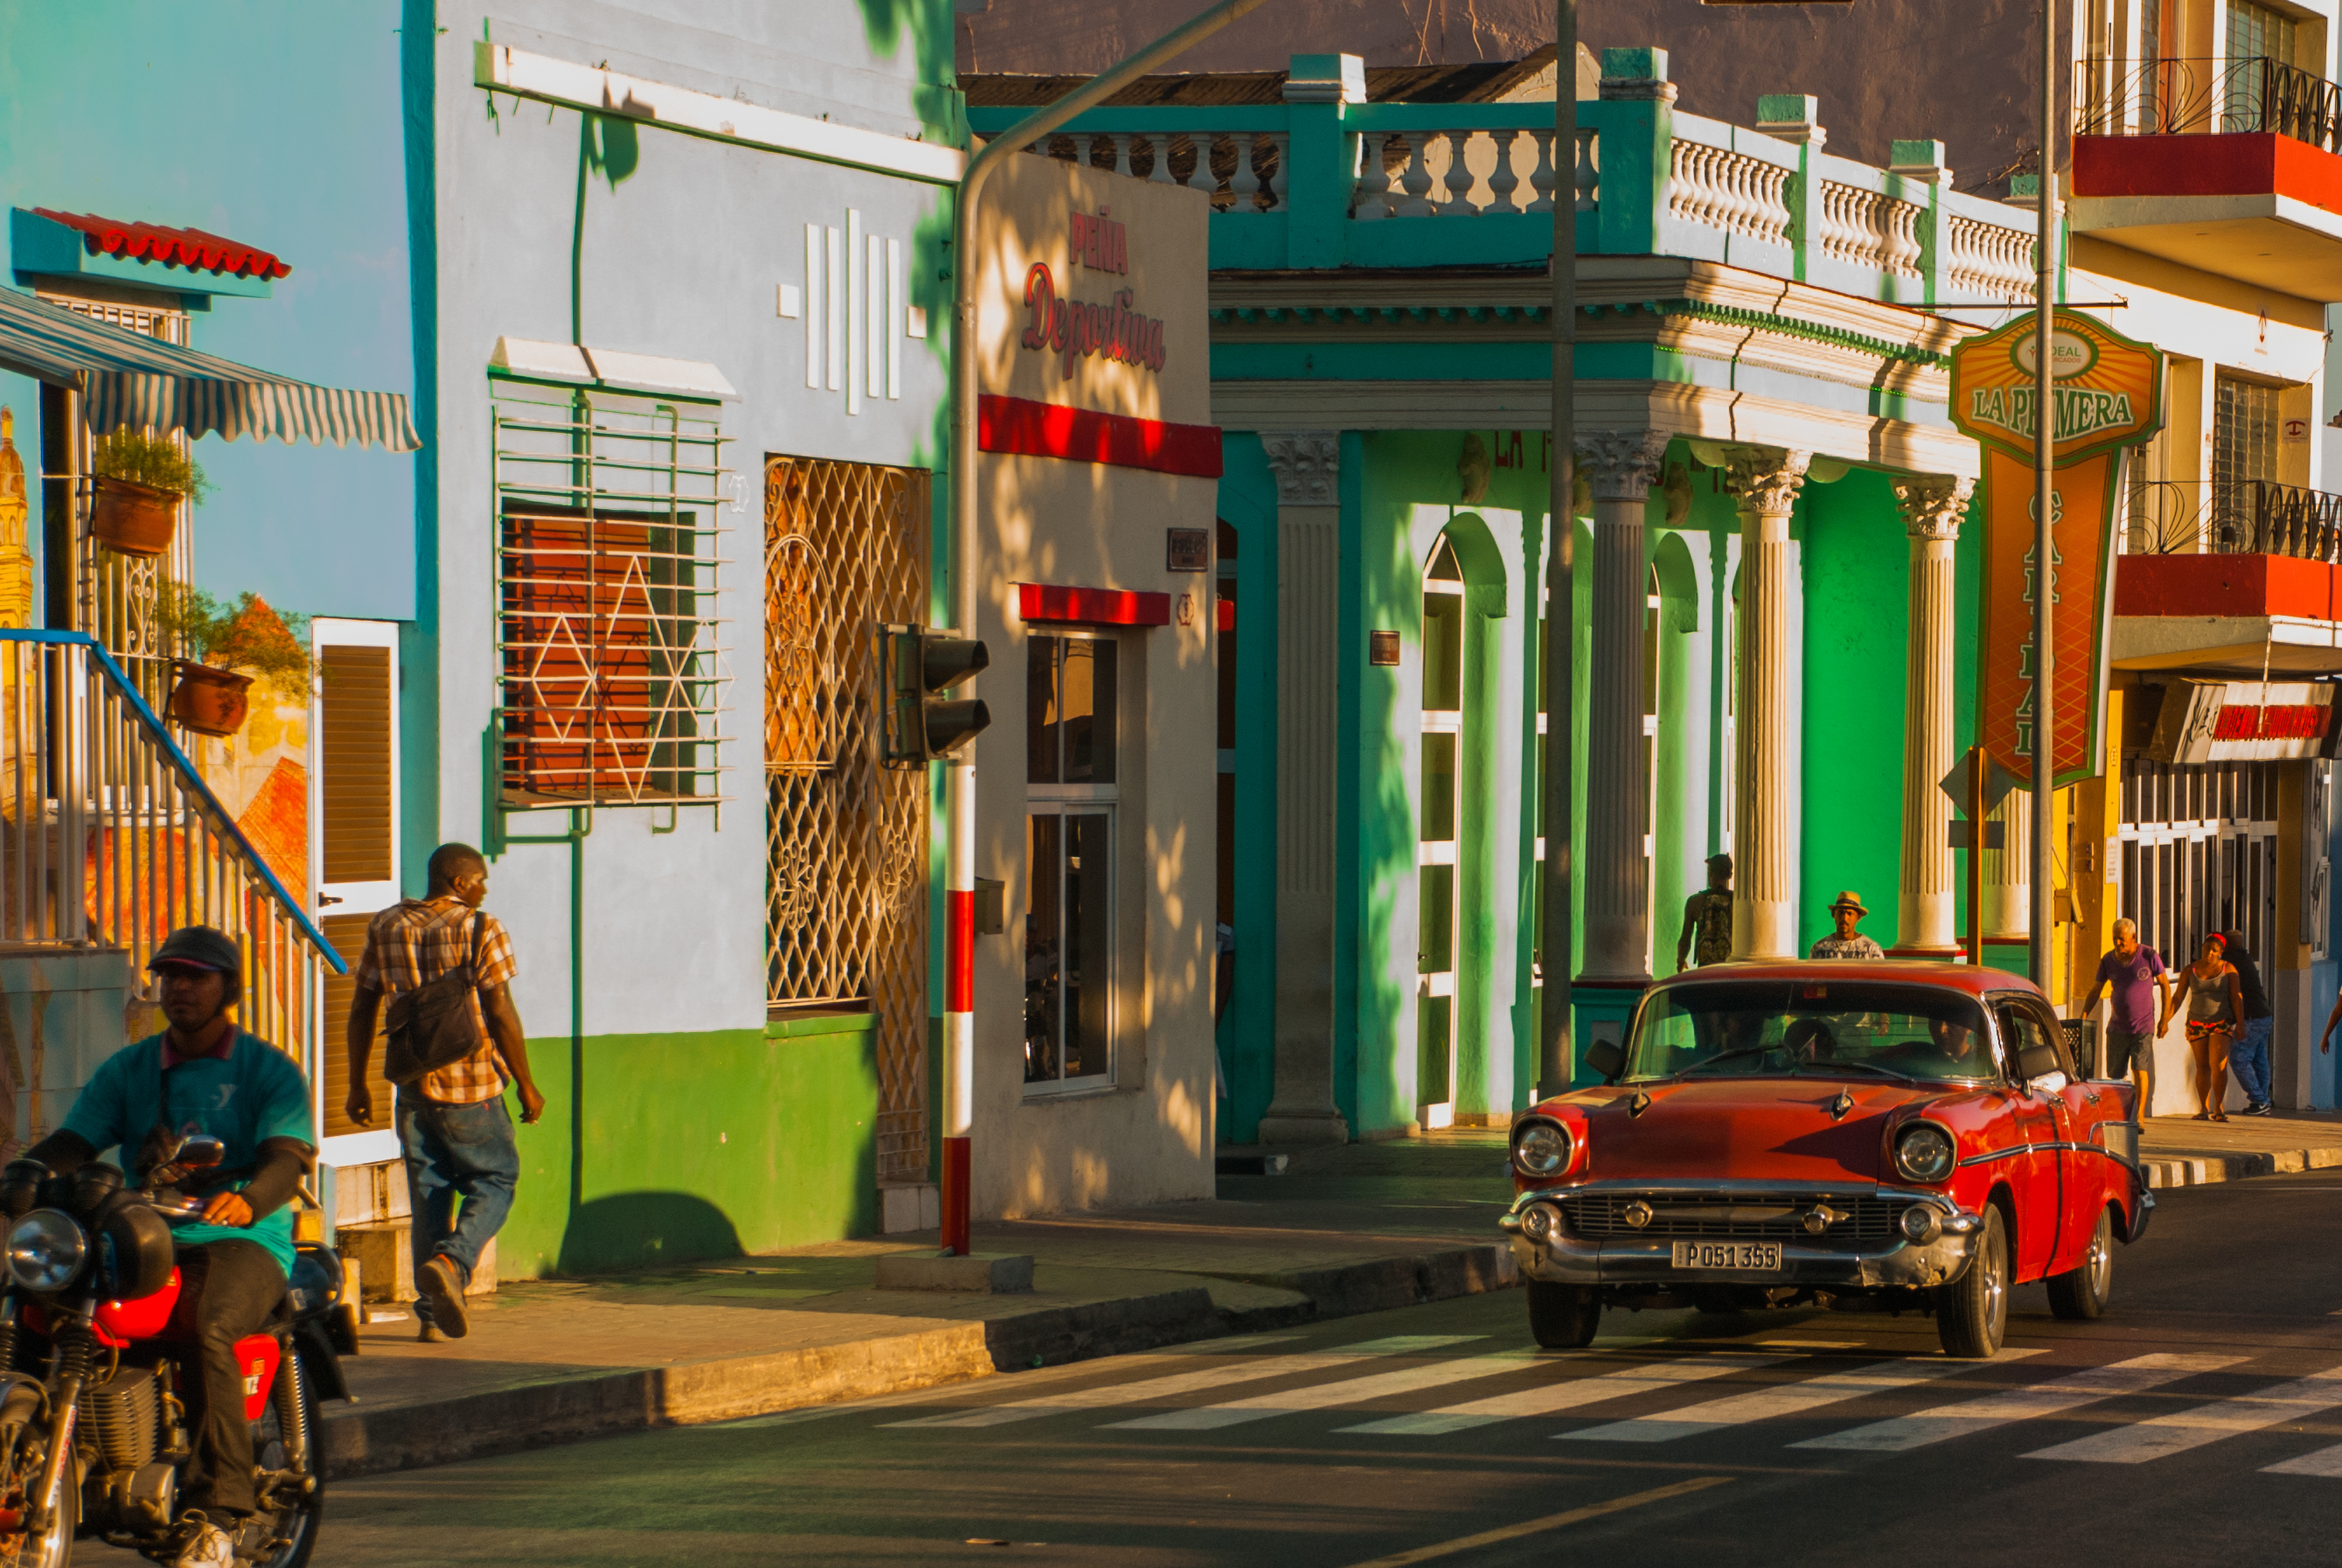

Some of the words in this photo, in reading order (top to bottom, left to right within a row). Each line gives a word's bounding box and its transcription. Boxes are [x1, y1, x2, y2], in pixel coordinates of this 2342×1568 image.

[1022, 262, 1166, 380] Deportiva
[1973, 388, 2007, 425] LA
[2010, 387, 2132, 440] PRMERA
[1703, 1245, 1738, 1268] 051
[1741, 1246, 1777, 1268] 355
